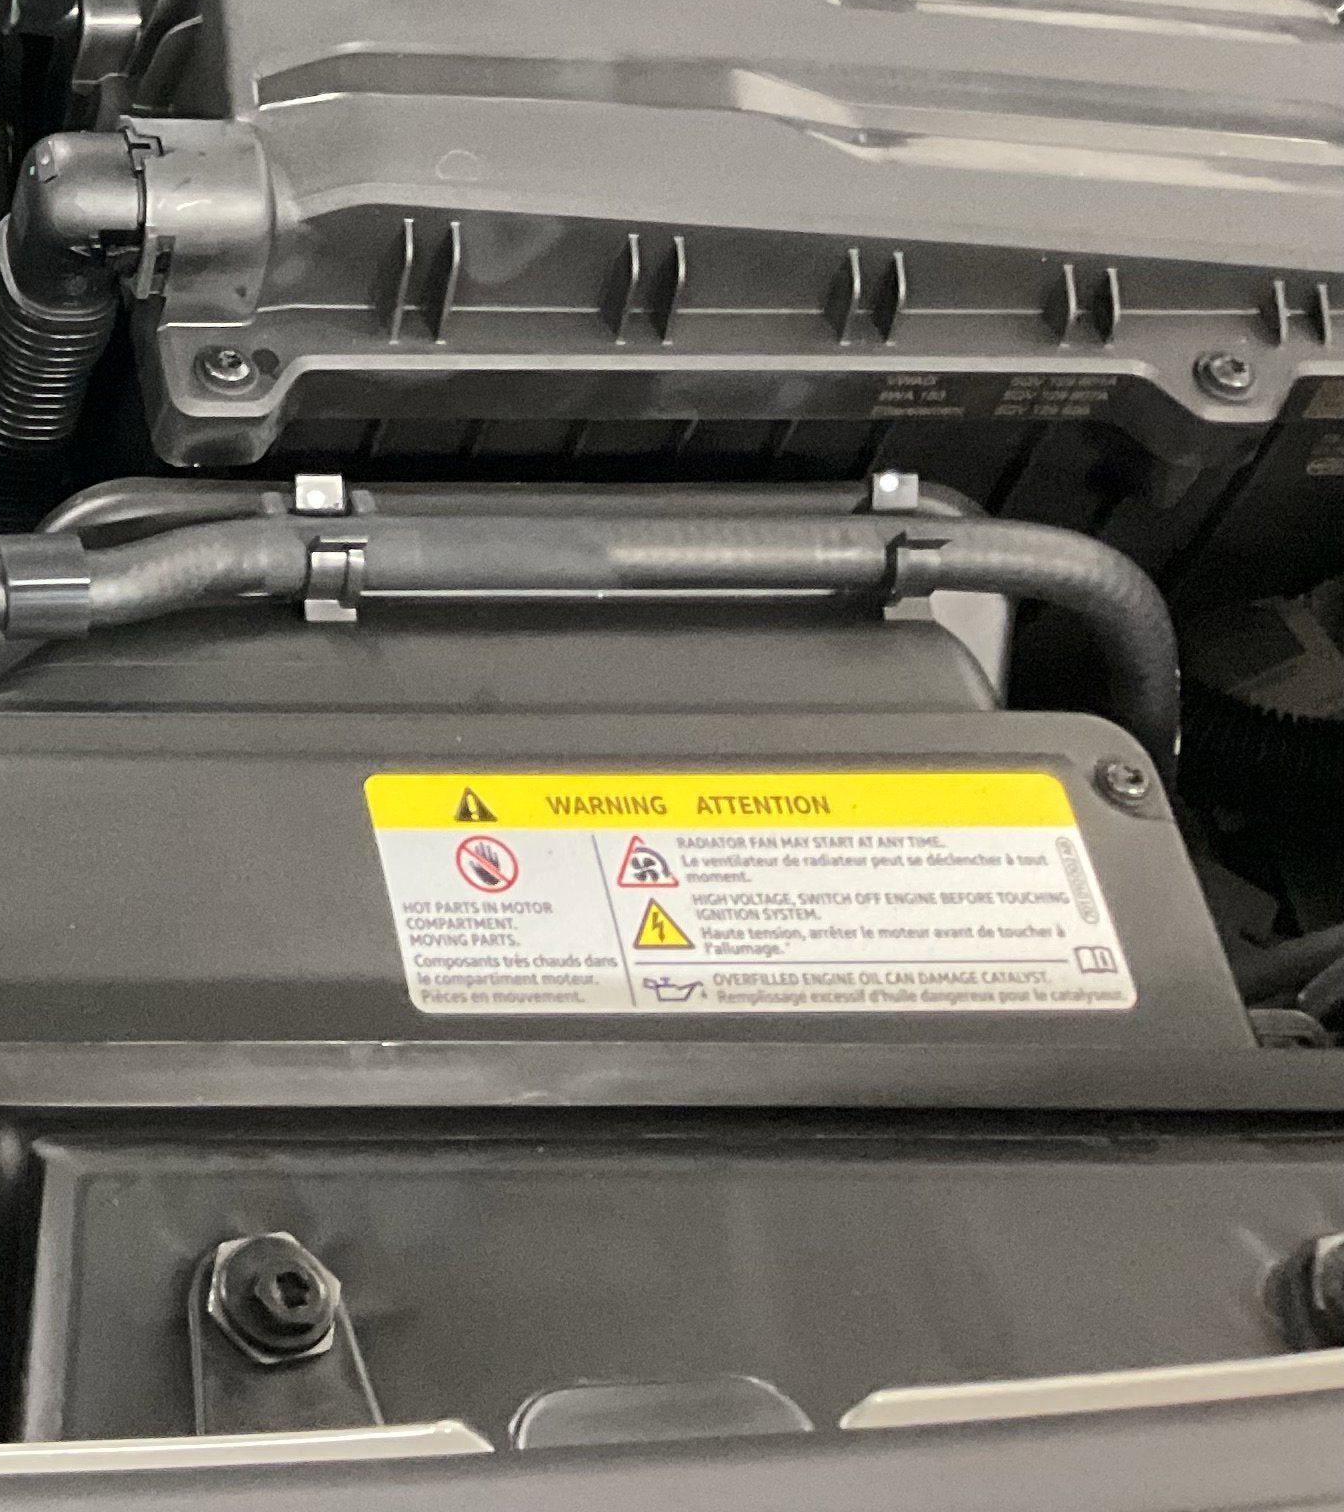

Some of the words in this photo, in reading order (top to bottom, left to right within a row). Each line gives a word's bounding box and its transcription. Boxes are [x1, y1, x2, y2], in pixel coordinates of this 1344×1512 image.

[546, 795, 668, 815] WARNING
[696, 795, 831, 815] ATTENTION
[676, 836, 745, 849] RADIATOR
[749, 836, 778, 849] FAN
[781, 836, 810, 849] MAY
[813, 836, 854, 849] START
[858, 836, 873, 849] AT
[877, 836, 904, 848] ANY
[907, 836, 946, 848] TIME.
[681, 855, 699, 867] Le
[701, 855, 779, 867] ventilateur
[782, 855, 799, 867] de
[803, 854, 867, 867] radiateur
[871, 855, 904, 869] peut
[907, 856, 923, 866] se
[926, 853, 1002, 866] déclencher
[1017, 854, 1049, 866] tout
[686, 871, 752, 883] moment.
[692, 893, 728, 905] HIGH
[731, 893, 797, 908] VOLTAGE,
[798, 893, 852, 905] SWITCH
[855, 893, 882, 905] OFF
[885, 892, 938, 905] ENGINE
[941, 892, 994, 905] BEFORE
[997, 892, 1071, 905] TOUCHING
[403, 901, 431, 914] HOT
[435, 902, 480, 914] PARTS
[483, 902, 499, 914] IN
[501, 902, 554, 915] MOTOR
[695, 908, 760, 921] IGNITION
[763, 908, 822, 921] SYSTEM.
[406, 917, 519, 930] COMPARTMENT.
[410, 933, 469, 947] MOVING
[472, 934, 520, 947] PARTS.
[701, 927, 745, 939] Haute
[748, 927, 806, 941] tension,
[809, 926, 858, 939] arrêter
[861, 926, 874, 939] le
[877, 927, 929, 938] moteur
[934, 927, 973, 938] avant
[977, 925, 993, 938] de
[997, 925, 1053, 938] toucher
[414, 954, 501, 971] Composants
[502, 954, 531, 967] très
[533, 954, 582, 968] chauds
[584, 954, 618, 968] dans
[417, 972, 432, 985] le
[434, 972, 538, 989] compartiment
[541, 974, 600, 986] moteur.
[713, 972, 799, 986] OVERFILLED
[802, 972, 855, 986] ENGINE
[860, 972, 883, 986] OIL
[885, 972, 915, 985] CAN
[918, 972, 978, 985] DAMAGE
[981, 971, 1052, 985] CATALYST.
[421, 990, 469, 1003] Pièces
[470, 992, 490, 1003] en
[493, 992, 586, 1004] mouvement.
[717, 990, 805, 1006] Remplissage
[811, 990, 865, 1004] excessif
[869, 990, 917, 1003] d'huile
[921, 990, 995, 1005] dangereux
[999, 990, 1030, 1004] pour
[1033, 990, 1048, 1002] le
